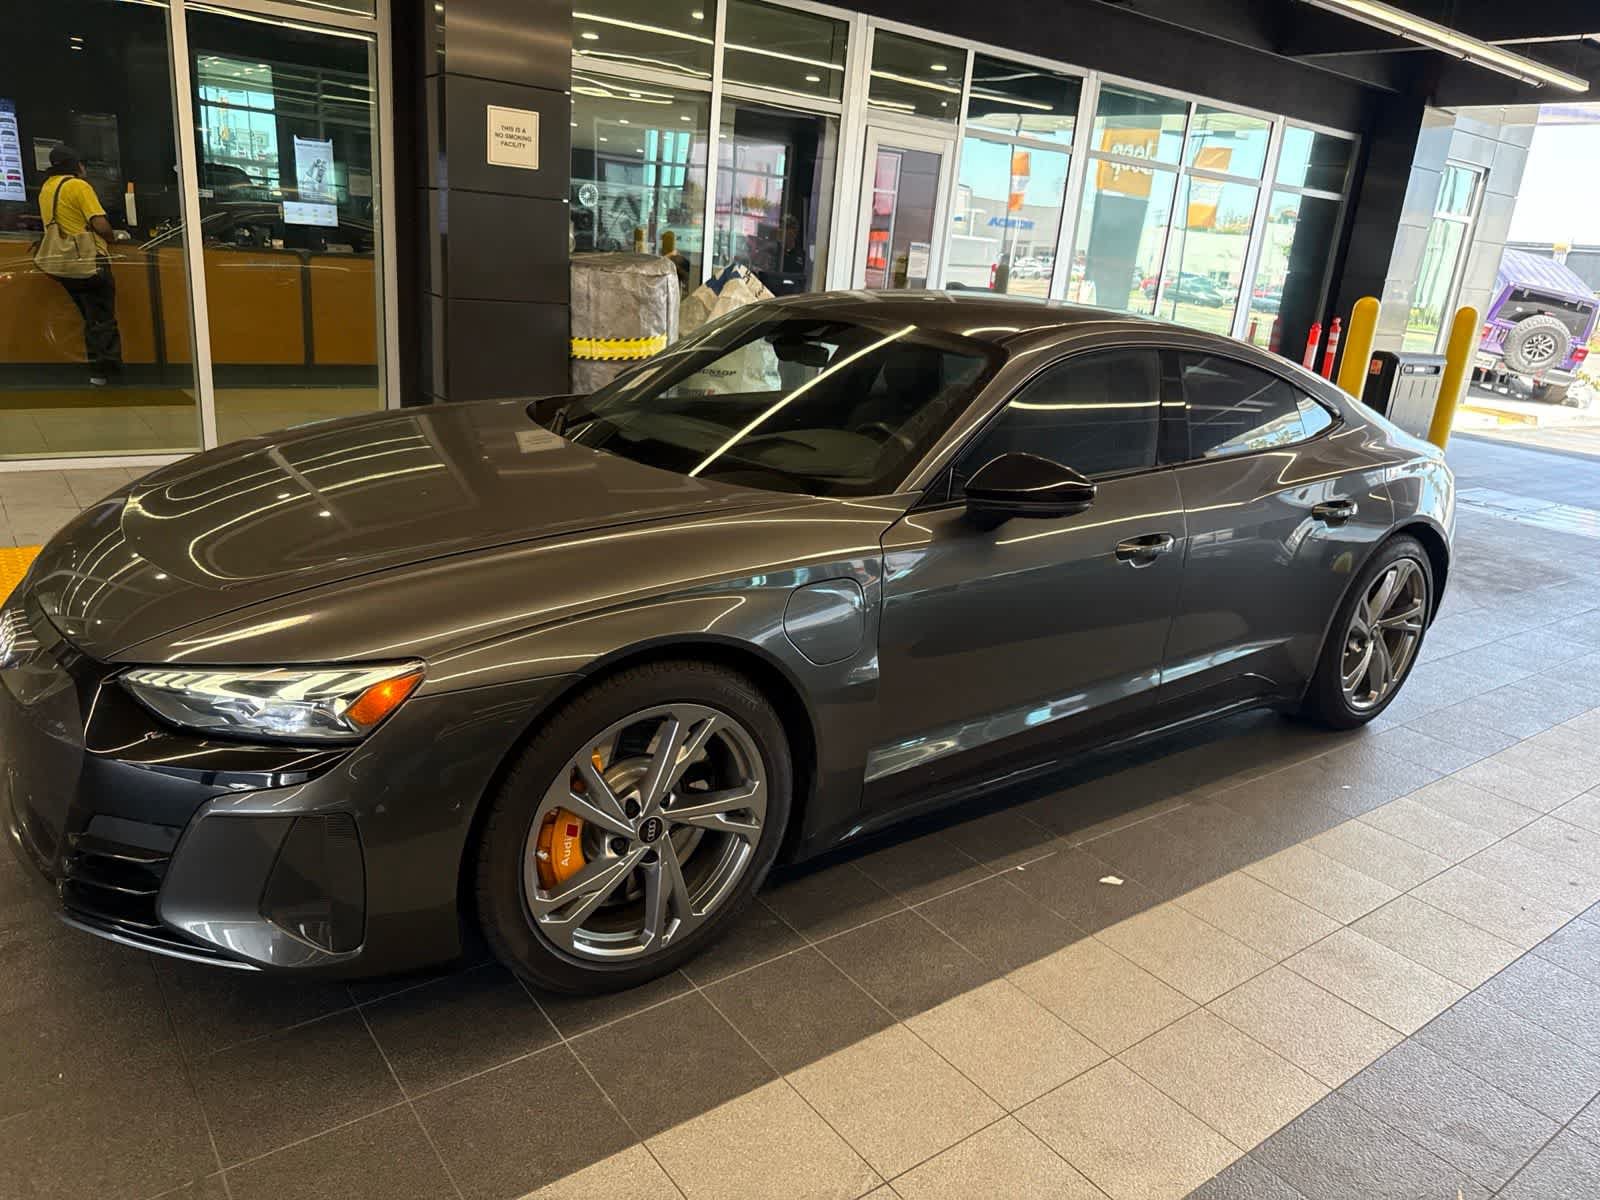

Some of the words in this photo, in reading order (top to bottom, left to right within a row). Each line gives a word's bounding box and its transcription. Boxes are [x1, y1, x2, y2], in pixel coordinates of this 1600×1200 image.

[505, 133, 532, 142] SMOKING
[500, 141, 526, 149] FACILITY
[561, 838, 572, 867] Audi
